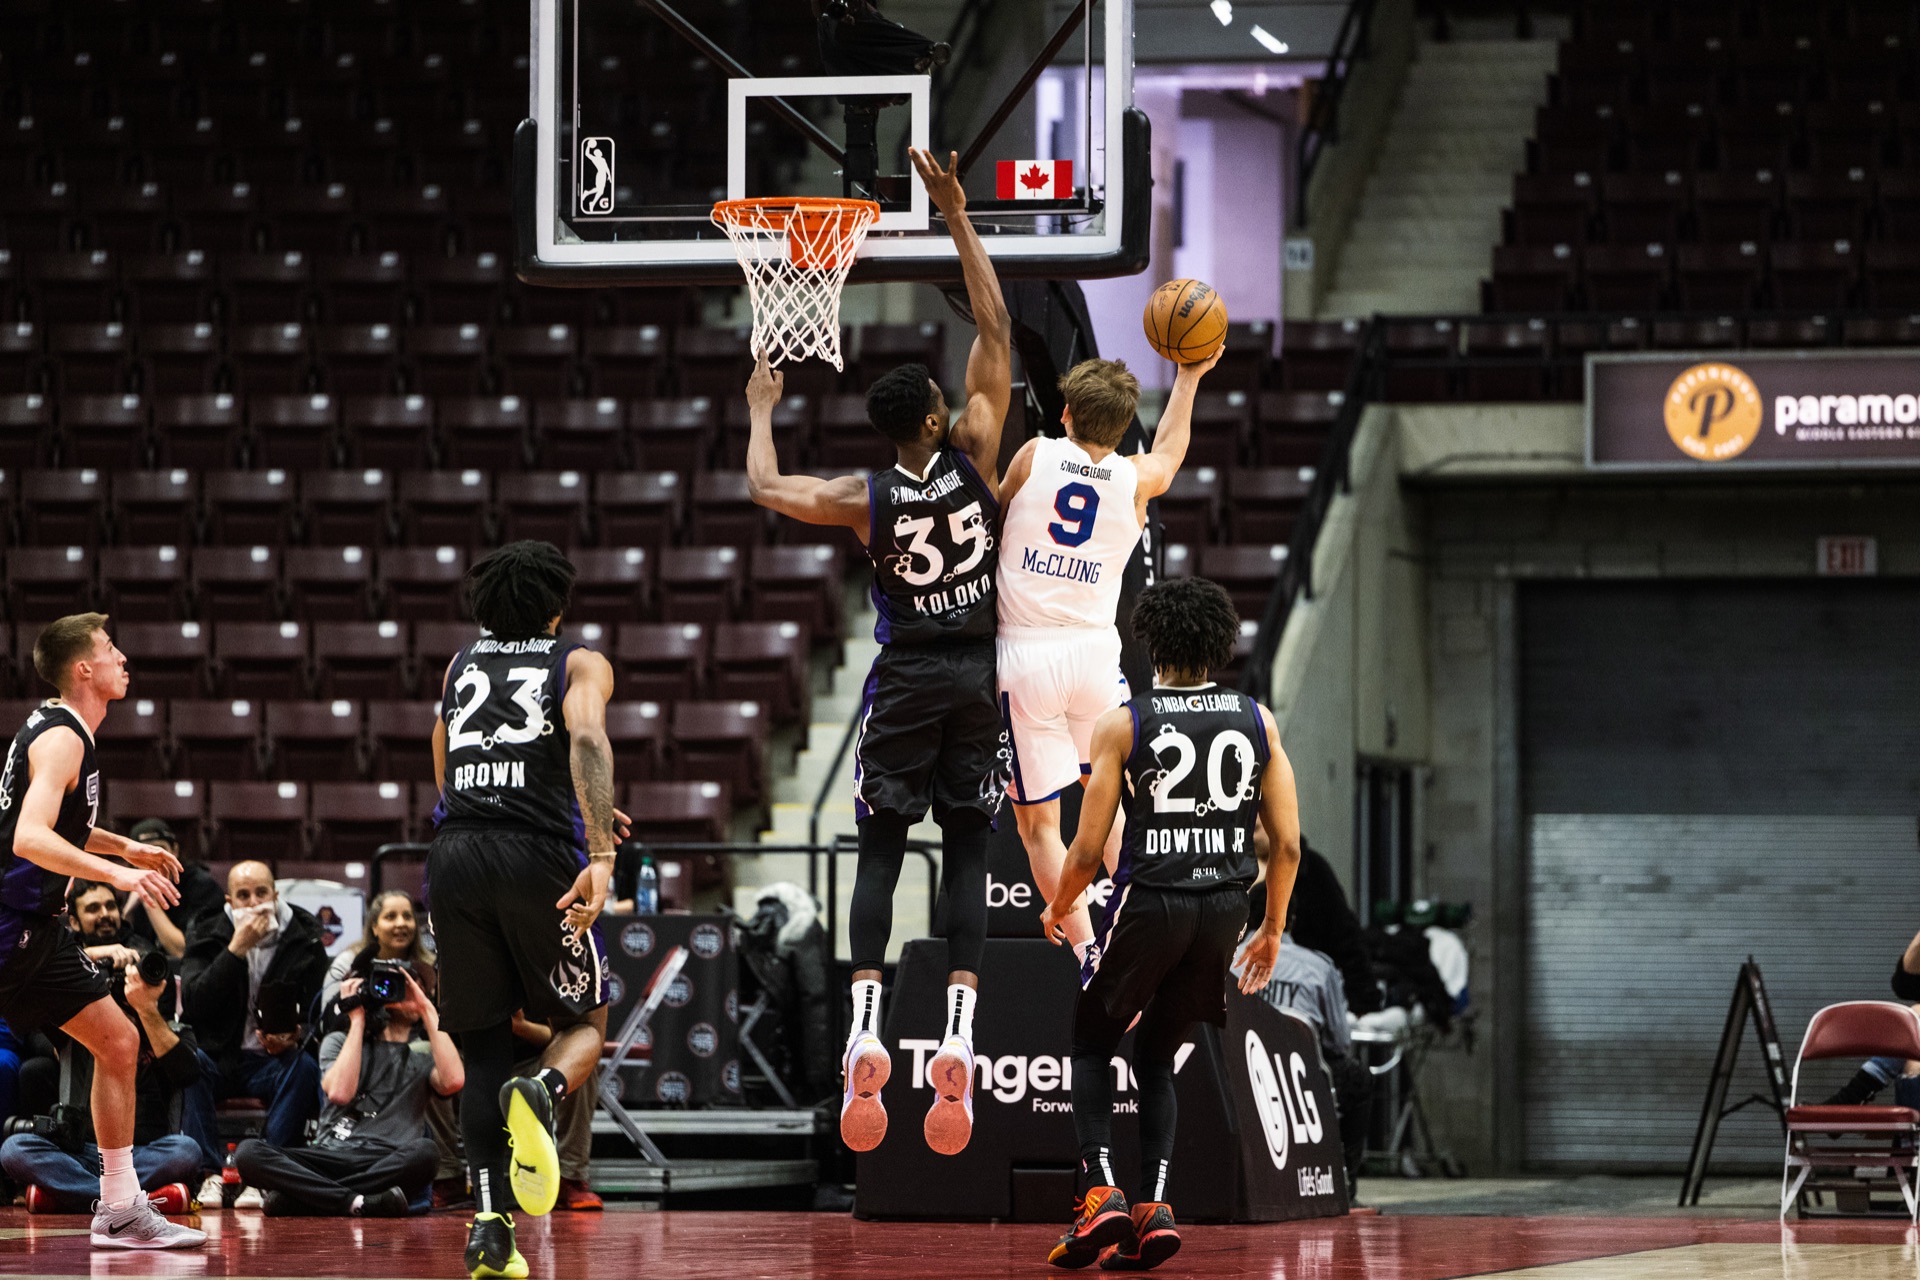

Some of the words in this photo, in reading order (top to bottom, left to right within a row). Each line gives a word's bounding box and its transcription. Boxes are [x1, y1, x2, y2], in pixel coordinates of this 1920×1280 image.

[1775, 394, 1920, 436] paramo
[1047, 481, 1100, 548] 9
[893, 500, 988, 586] 35
[1021, 546, 1102, 584] McCLUNG
[450, 667, 549, 753] 23
[454, 761, 525, 791] BROWN
[1149, 729, 1256, 814] 20
[1145, 828, 1225, 855] DOWTIN
[1231, 827, 1245, 853] JR
[985, 872, 1032, 908] be
[1273, 1051, 1324, 1144] LG
